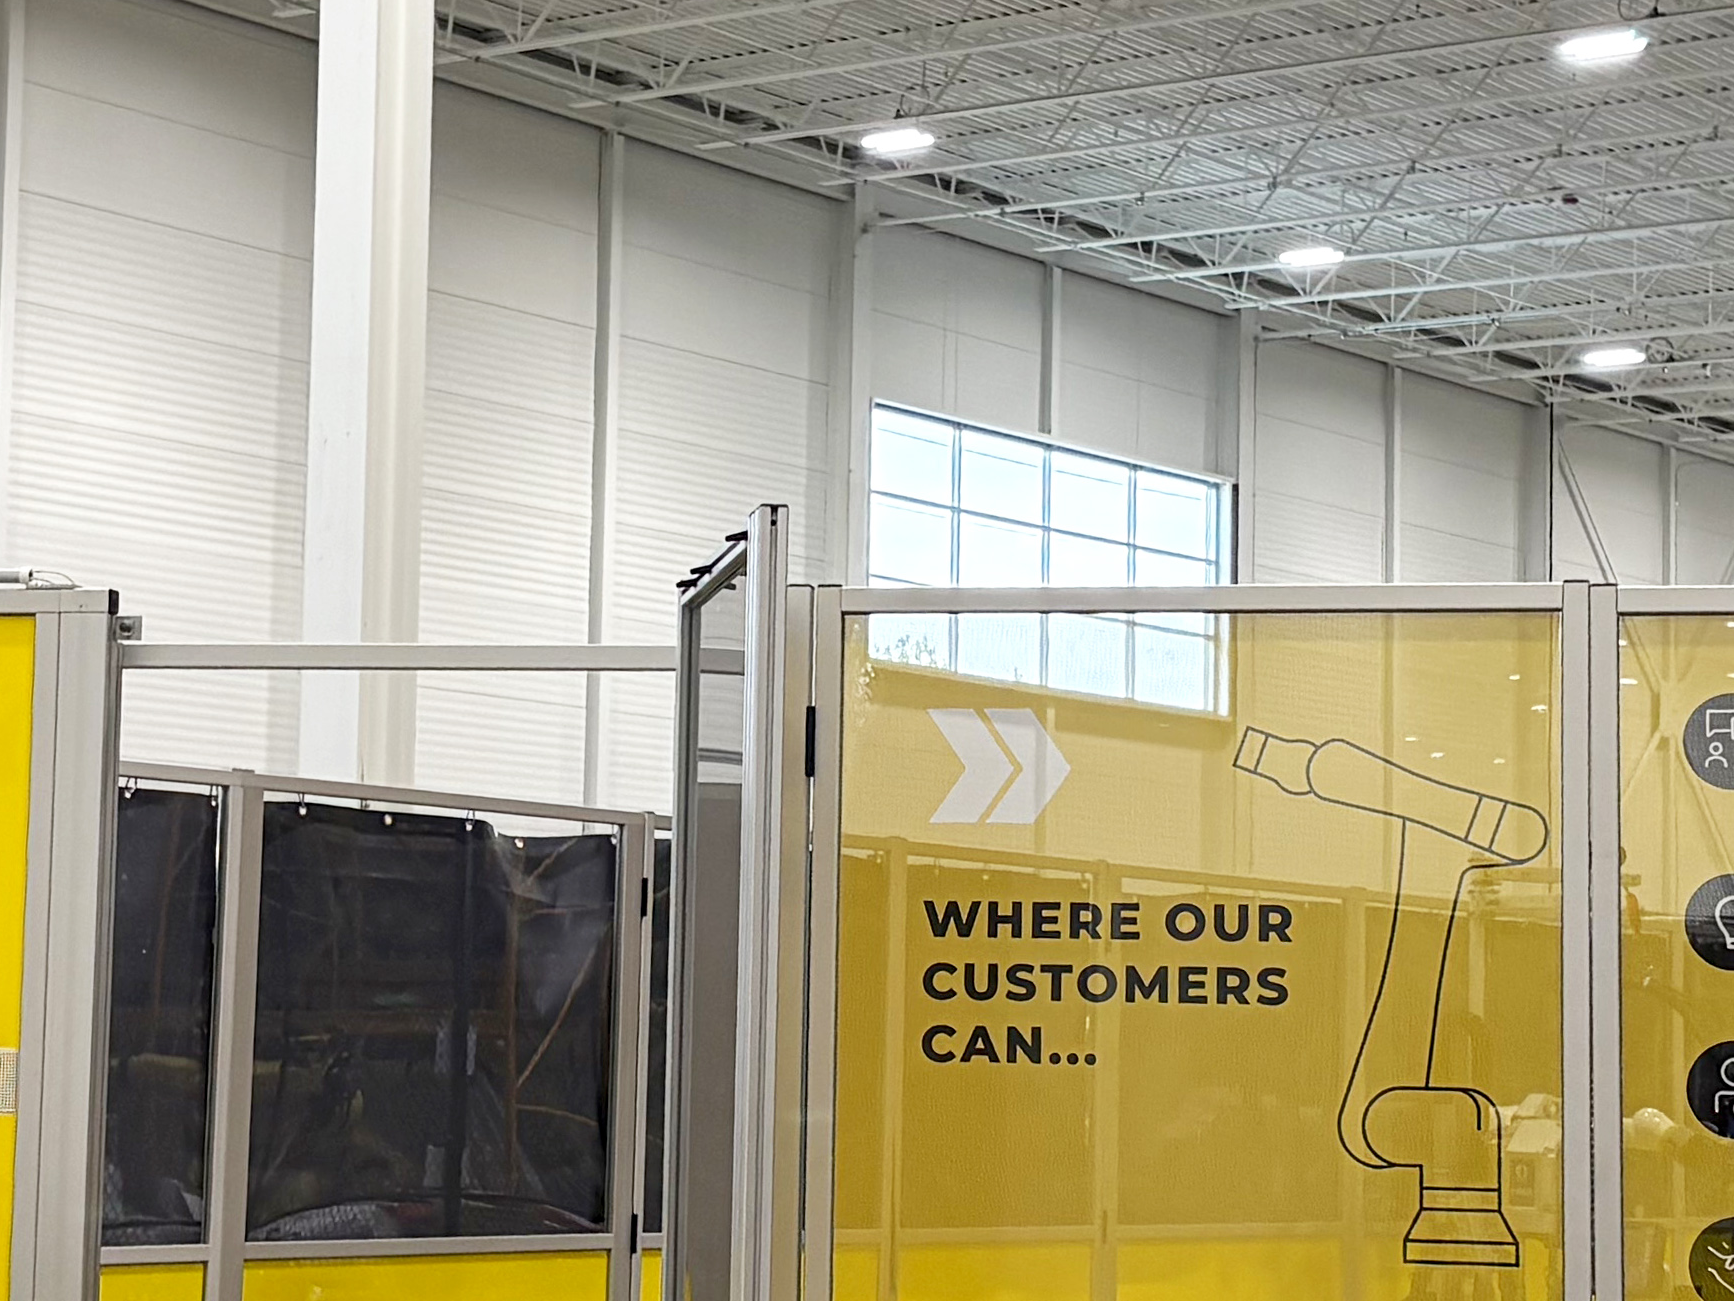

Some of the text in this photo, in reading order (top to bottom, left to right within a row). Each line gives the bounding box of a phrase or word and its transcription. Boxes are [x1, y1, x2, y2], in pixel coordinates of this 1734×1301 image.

[923, 899, 1293, 943] WHERE OUR
[921, 961, 1289, 1006] CUSTOMERS
[920, 1023, 1098, 1066] CAN...
